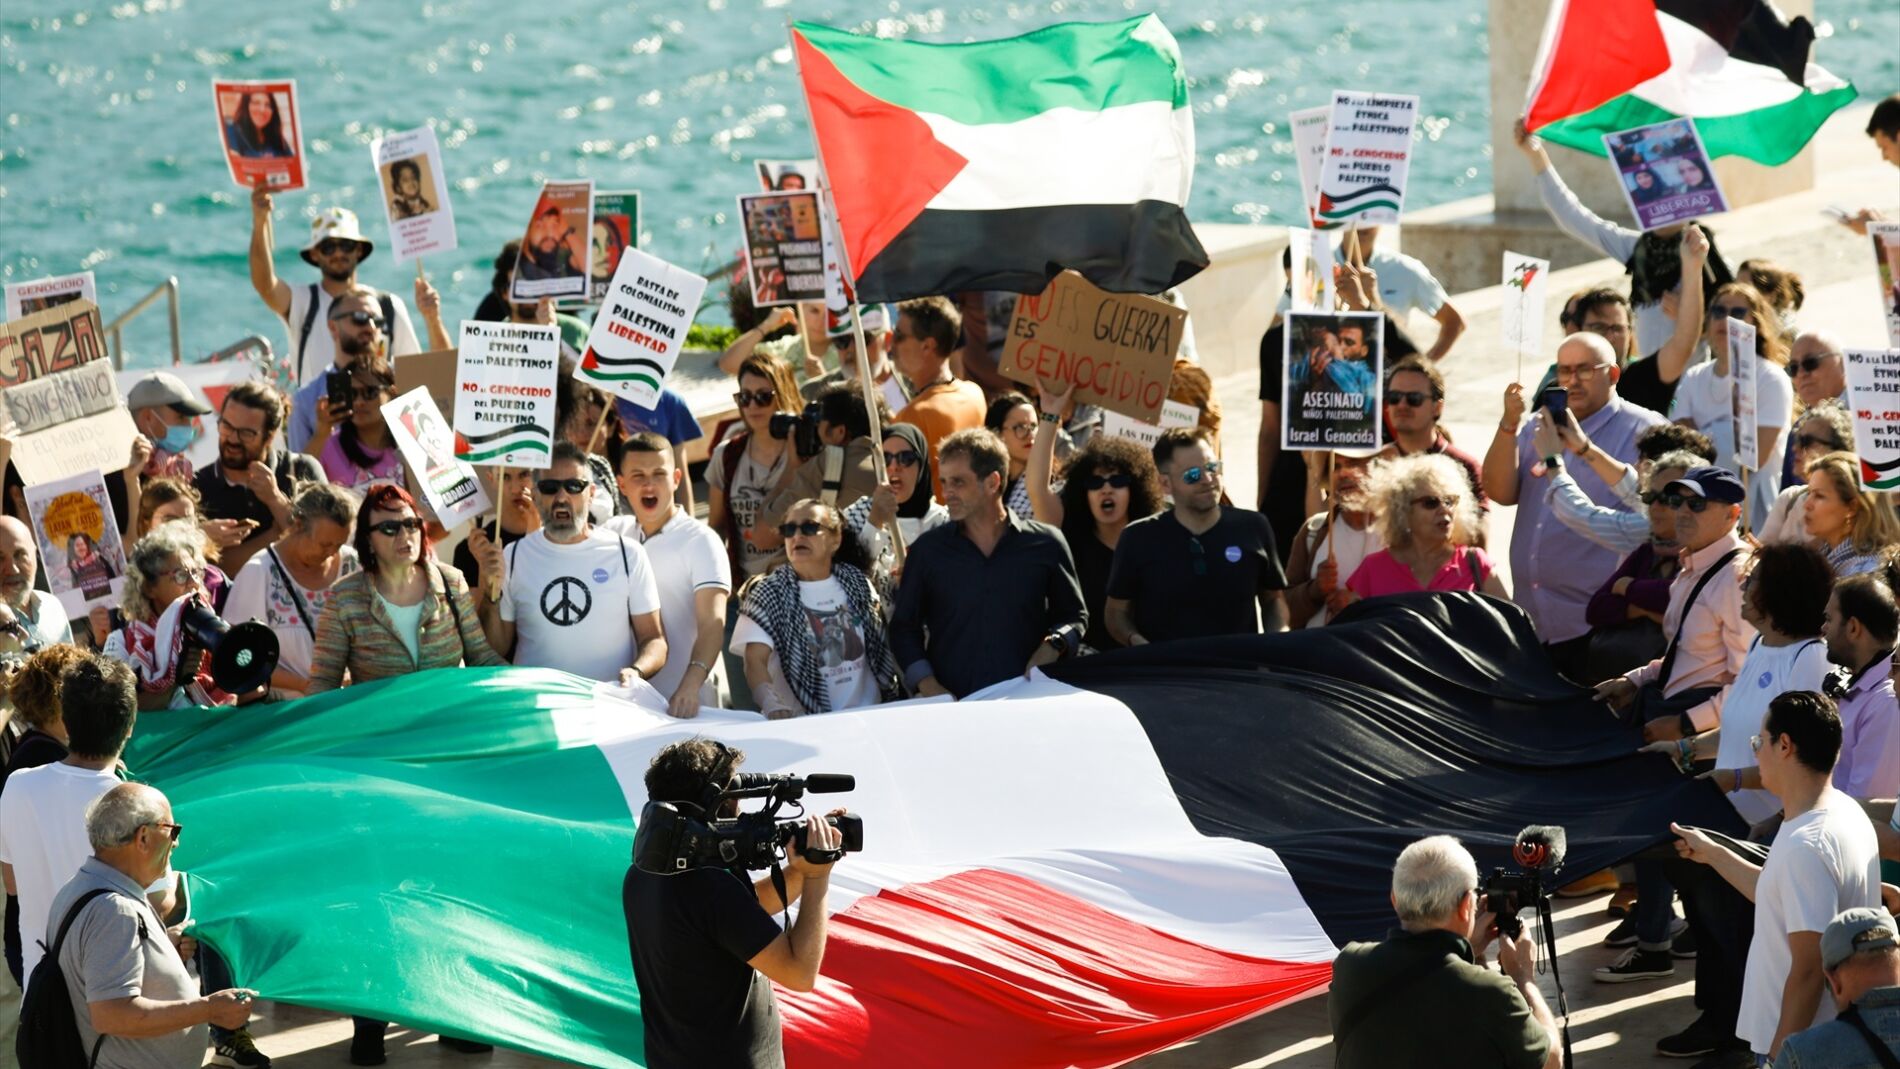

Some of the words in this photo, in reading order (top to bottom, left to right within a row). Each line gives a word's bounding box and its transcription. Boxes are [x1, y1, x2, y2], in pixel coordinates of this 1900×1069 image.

[1337, 96, 1350, 104] NO
[1366, 99, 1413, 109] LIMPIEZA
[1352, 123, 1409, 135] PALESTINOS
[1331, 148, 1344, 156] NO
[1353, 148, 1407, 160] GENOCIDIO
[1353, 162, 1391, 172] PUEBLO
[1338, 174, 1390, 185] PALESTINO
[1648, 195, 1711, 217] LIBERTAD
[17, 277, 84, 297] GENOCIDIO
[636, 276, 665, 295] BASTA
[667, 289, 680, 300] DE
[620, 284, 685, 318] COLONIALISMO
[612, 304, 676, 340] PALESTINA
[1018, 279, 1056, 322] NO
[1093, 298, 1171, 356] GUERRA
[466, 326, 481, 336] NO
[501, 329, 554, 341] LIMPIEZA
[1014, 318, 1040, 339] ES
[608, 322, 667, 354] LIBERTAD
[0, 312, 101, 388] GAZA
[489, 340, 529, 354] ÉTNICA
[486, 356, 552, 370] PALESTINOS
[1849, 354, 1863, 364] NO
[1015, 339, 1165, 410] GENOCIDIO
[463, 382, 478, 392] NO
[489, 385, 551, 398] GENOCIDIO
[491, 399, 535, 411] PUEBLO
[1302, 392, 1365, 408] ASESINATO
[475, 412, 535, 424] PALESTINO
[1163, 408, 1193, 422] ESTINA
[1302, 409, 1323, 419] NIÑOS
[1326, 410, 1364, 421] PALESTINOS
[1857, 410, 1872, 420] NO
[1120, 427, 1137, 439] LAS
[1290, 427, 1319, 442] Israel
[1324, 428, 1374, 443] Genocida
[1872, 427, 1885, 435] DEL
